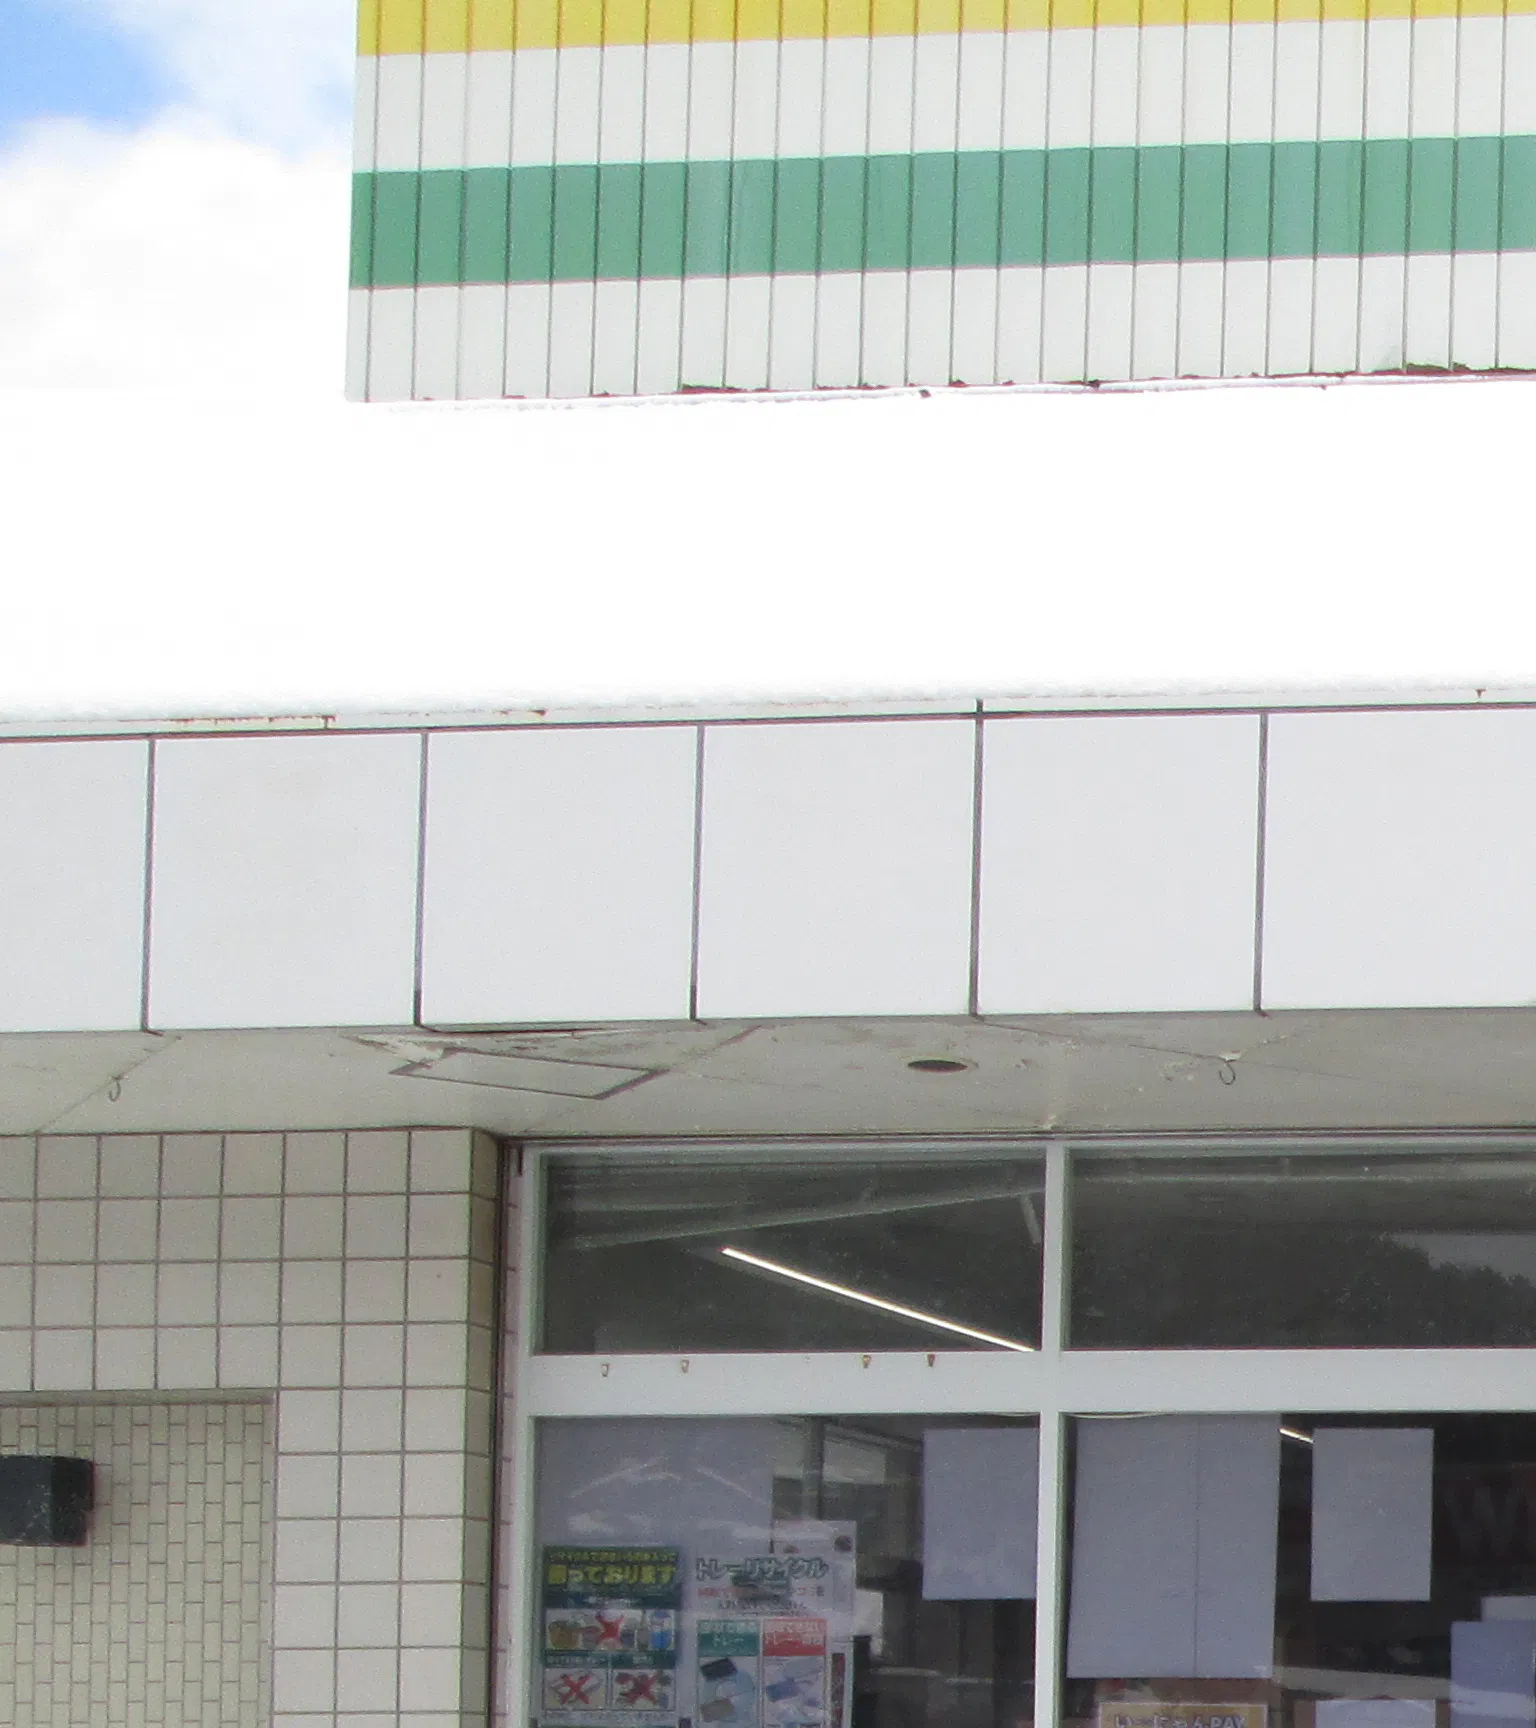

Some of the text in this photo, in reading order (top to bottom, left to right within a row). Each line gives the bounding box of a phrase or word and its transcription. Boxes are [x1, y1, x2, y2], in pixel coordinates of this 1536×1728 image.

[696, 1555, 830, 1581] トレーリサイクル
